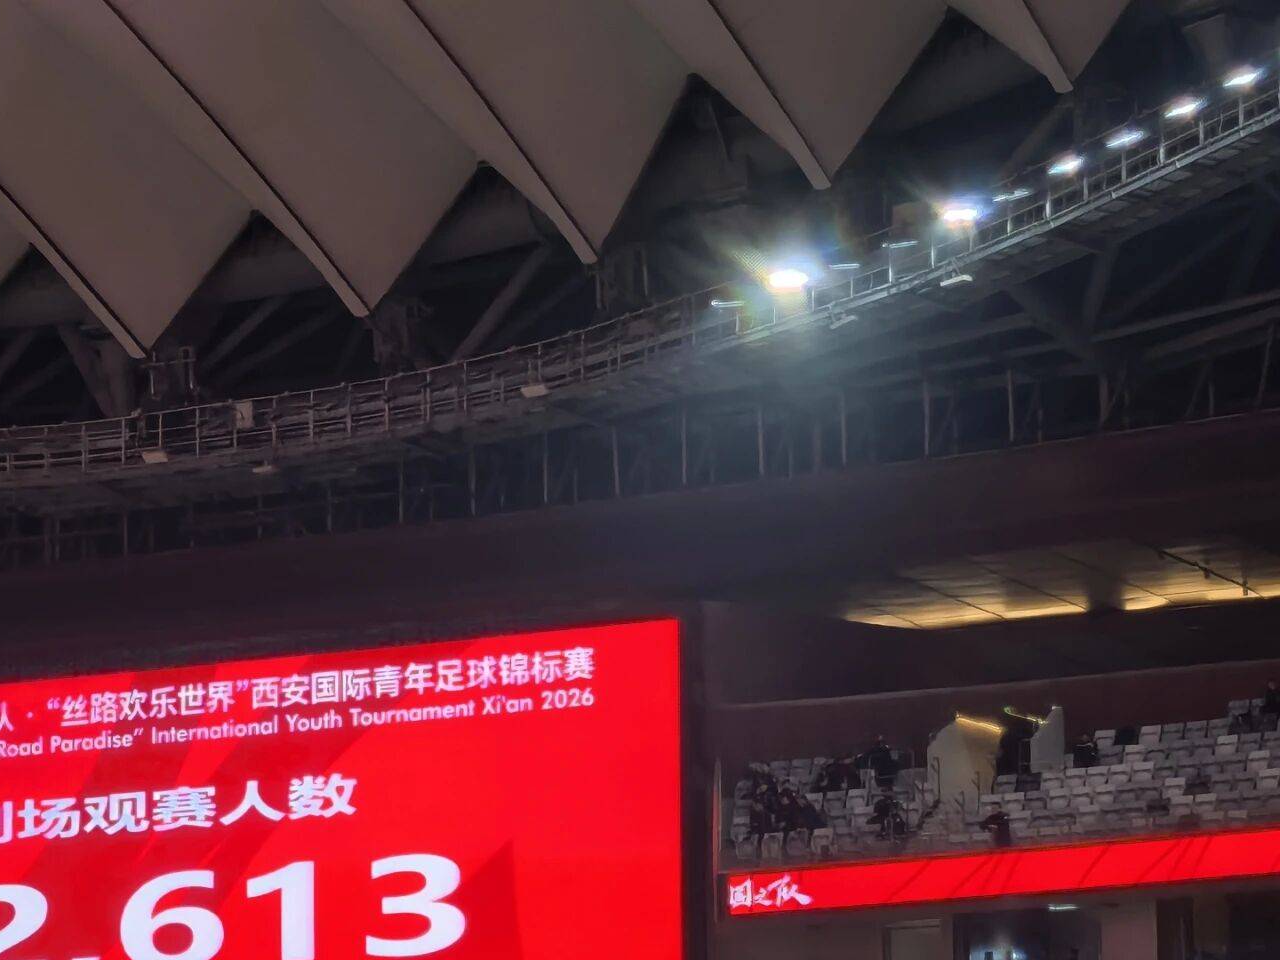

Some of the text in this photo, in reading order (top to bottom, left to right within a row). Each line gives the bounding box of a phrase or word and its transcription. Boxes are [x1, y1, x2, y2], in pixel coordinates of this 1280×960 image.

[152, 715, 278, 744] International
[286, 710, 342, 731] Youth
[349, 701, 474, 726] Tournament
[542, 688, 594, 709] 2026
